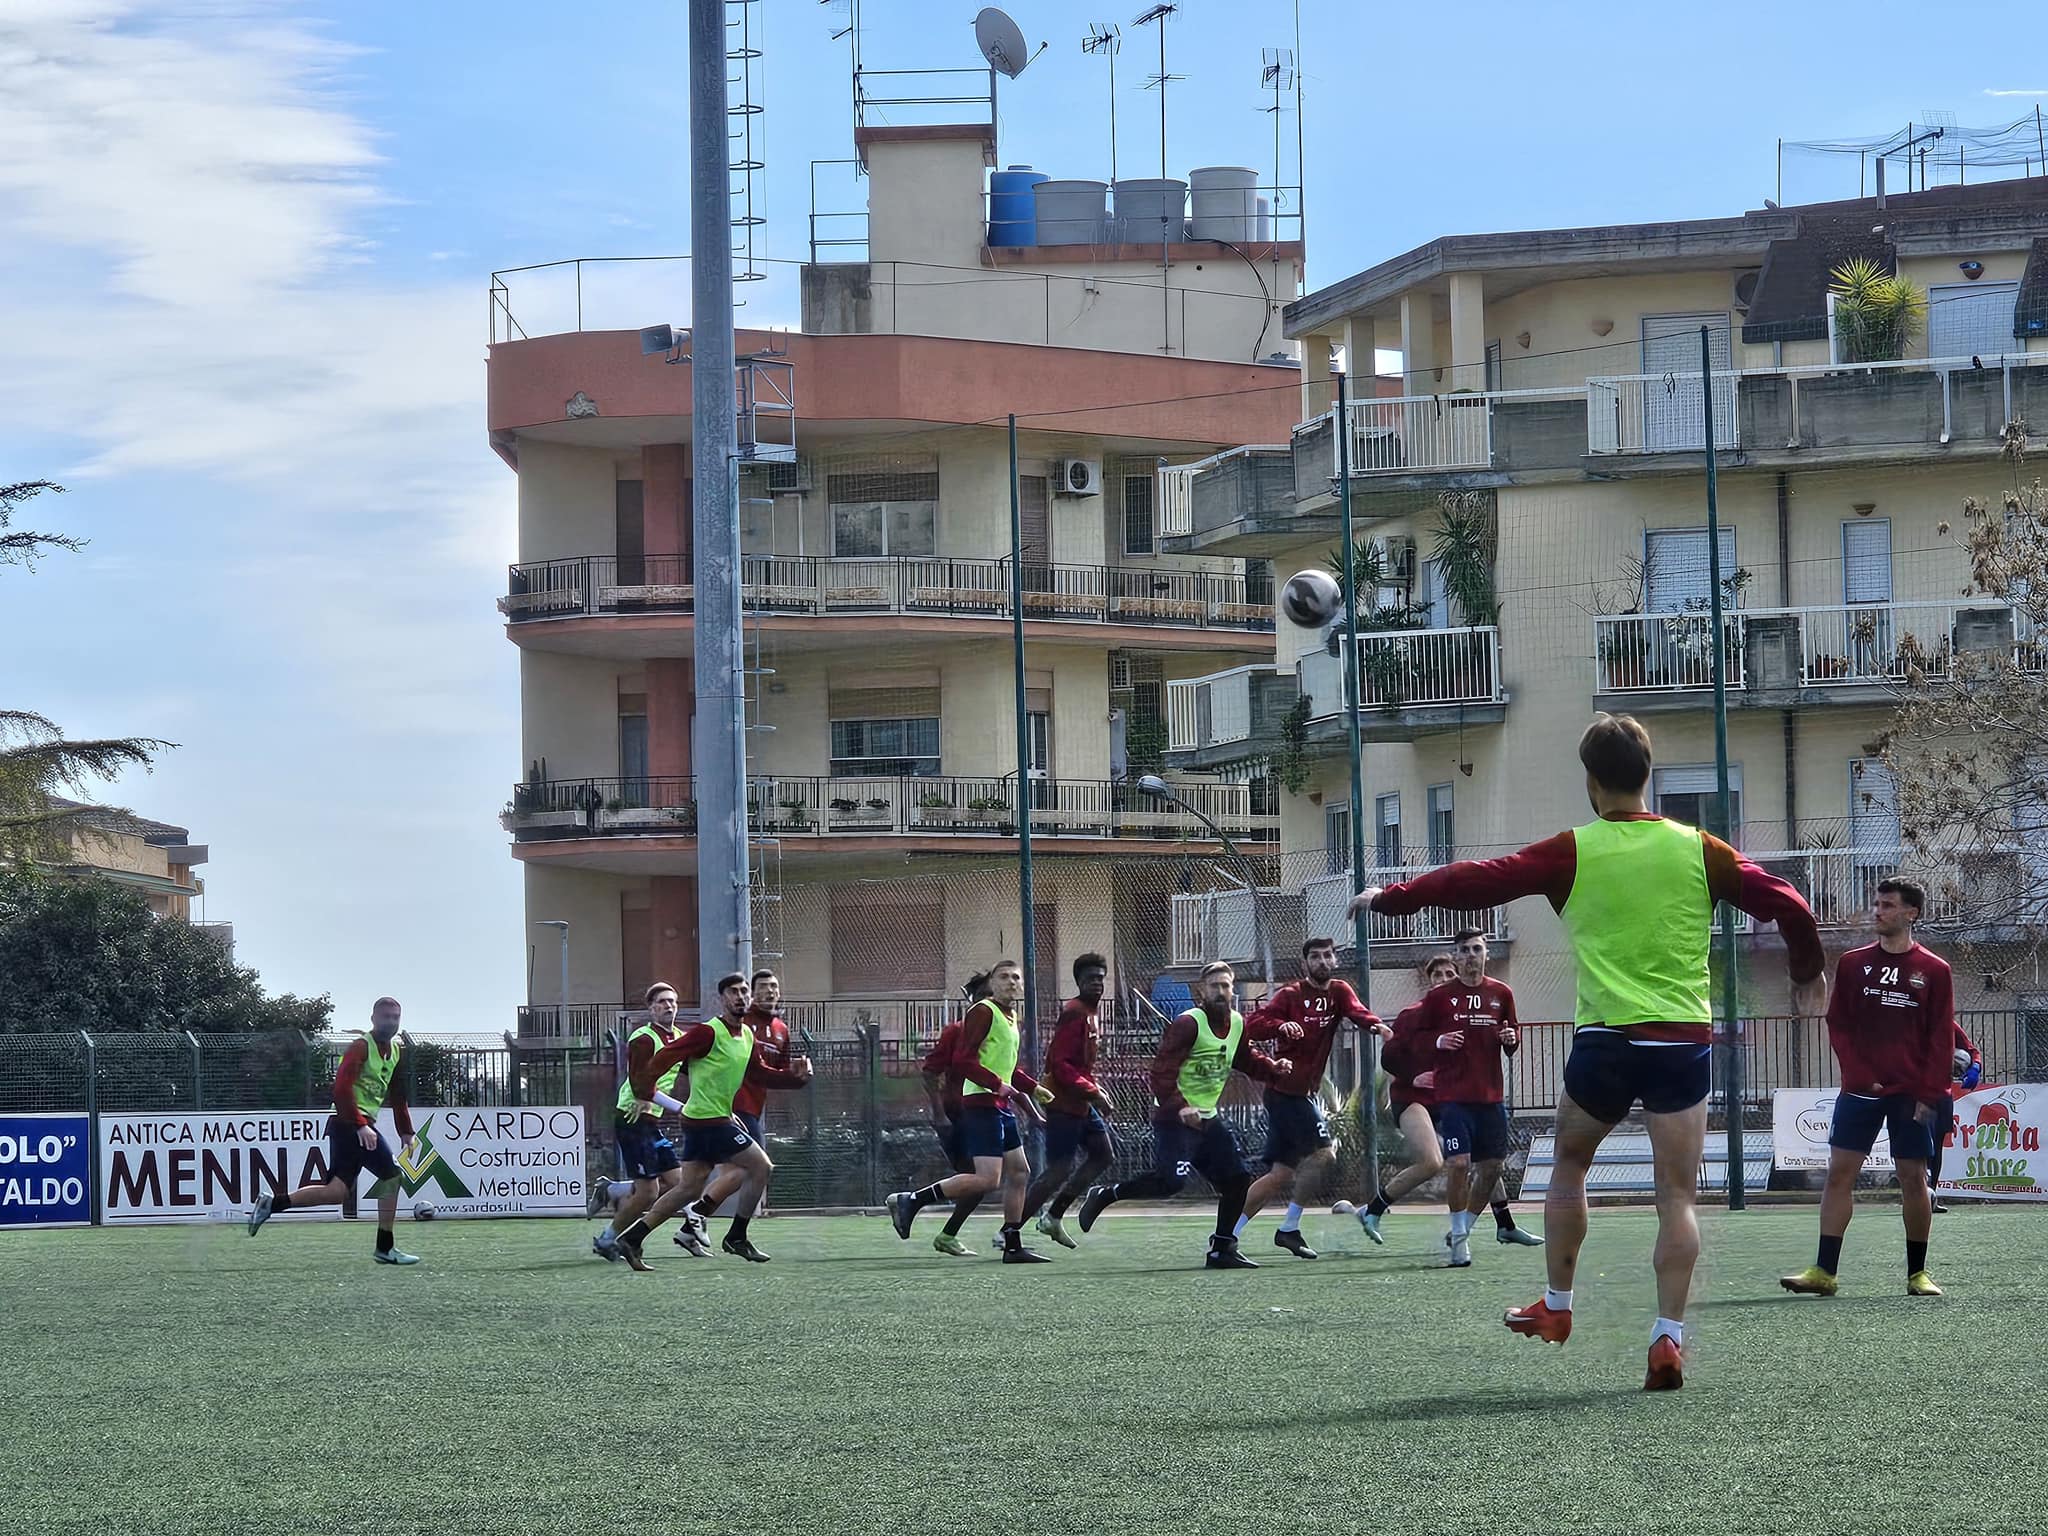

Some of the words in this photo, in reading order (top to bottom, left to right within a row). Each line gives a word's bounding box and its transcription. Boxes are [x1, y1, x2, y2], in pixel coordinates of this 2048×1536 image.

[1880, 966, 1899, 986] 24
[1315, 997, 1328, 1012] 21
[1466, 994, 1482, 1010] 70
[109, 1122, 195, 1145] ANTICA
[444, 1111, 580, 1141] SARDO
[460, 1146, 580, 1168] Costruzioni
[1966, 1151, 2028, 1178] store
[107, 1146, 330, 1208] MENNA
[479, 1176, 582, 1197] Metalliche
